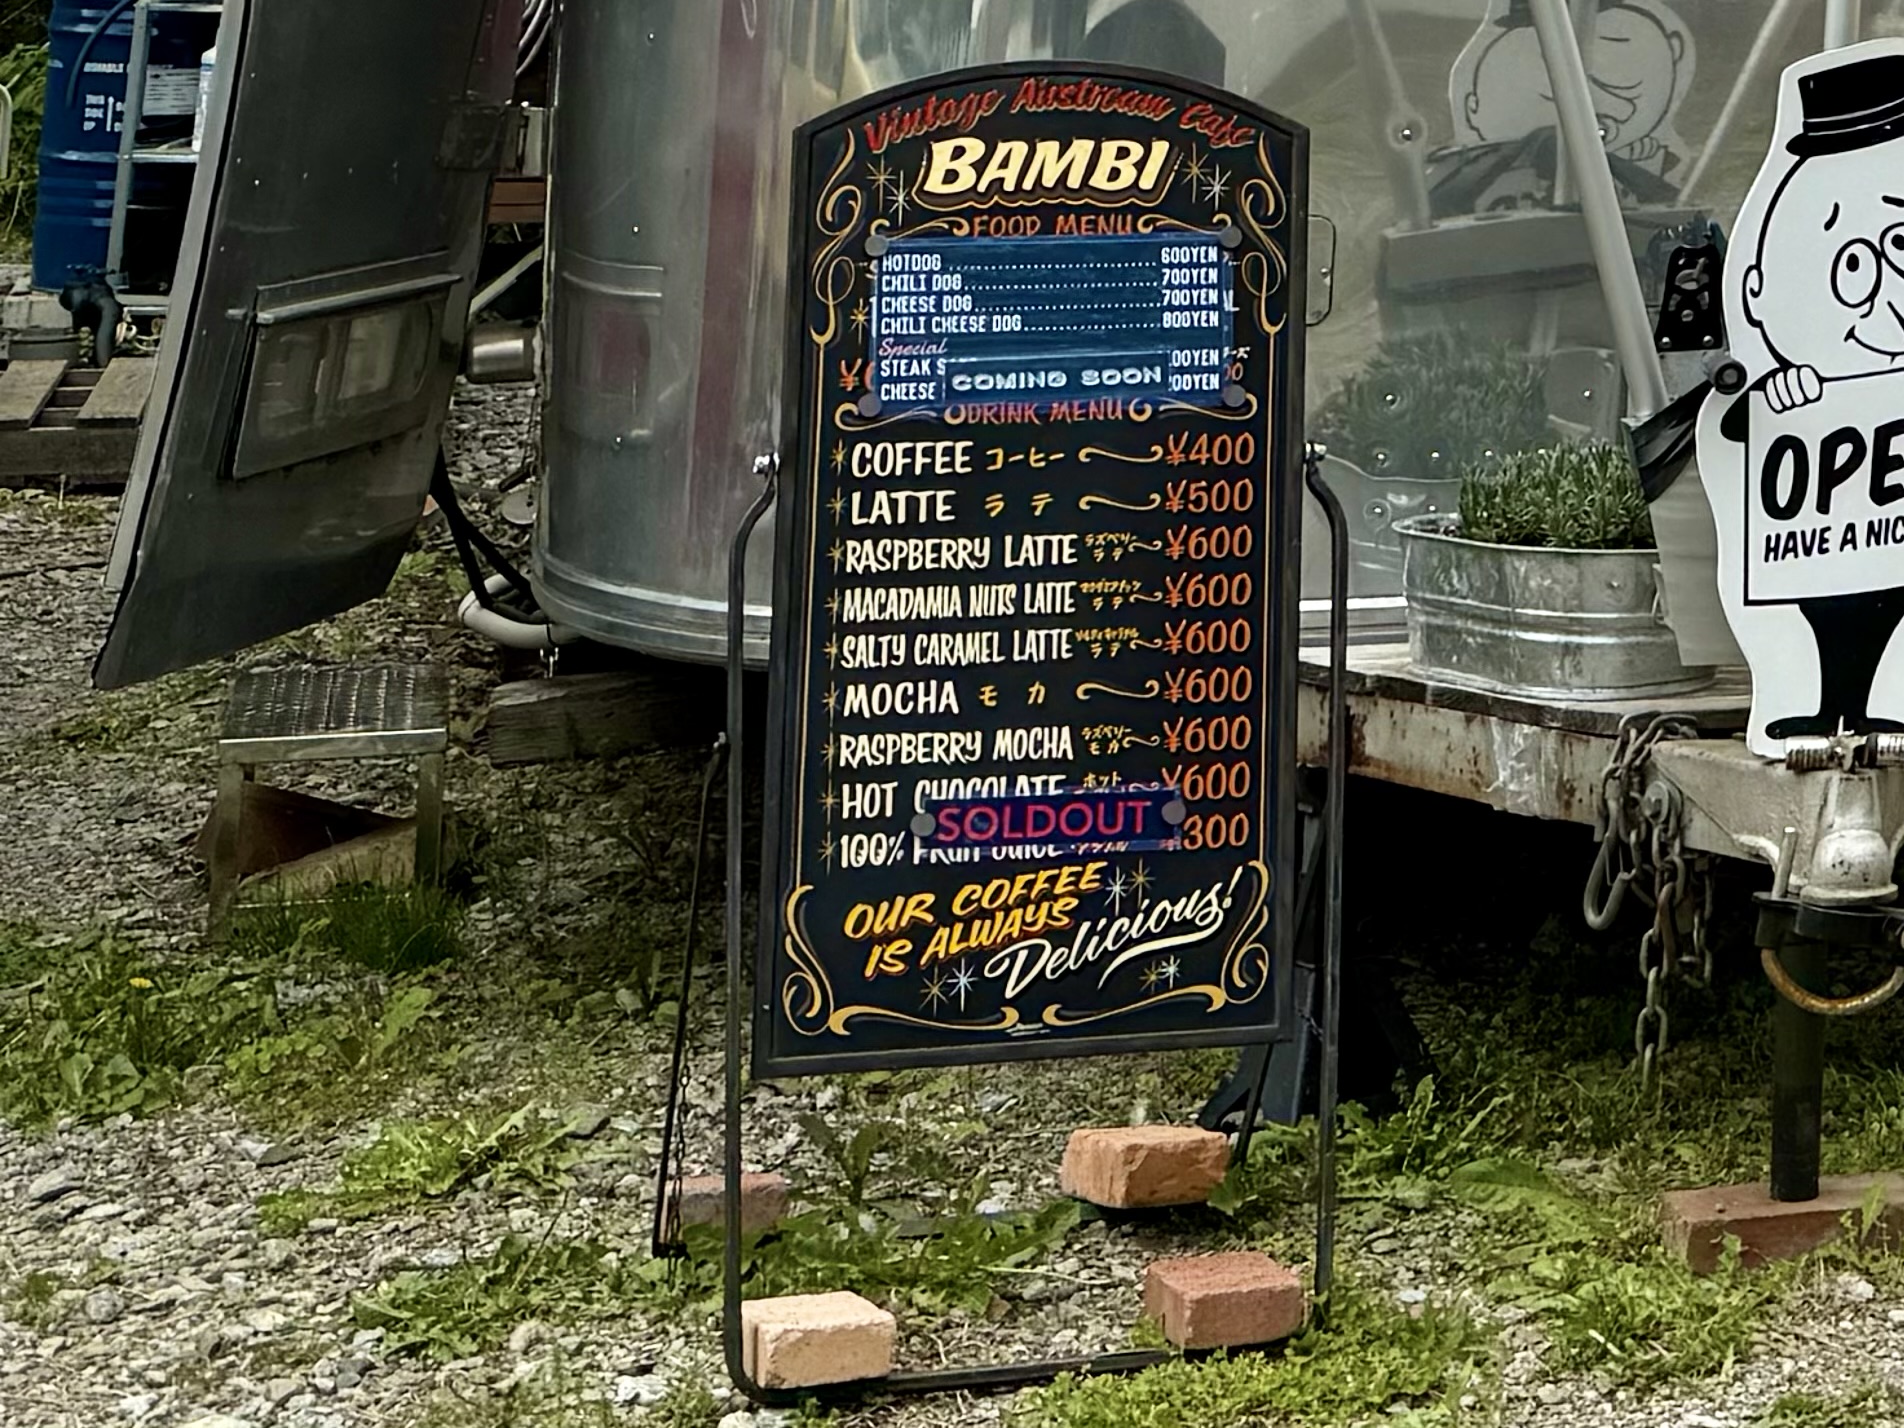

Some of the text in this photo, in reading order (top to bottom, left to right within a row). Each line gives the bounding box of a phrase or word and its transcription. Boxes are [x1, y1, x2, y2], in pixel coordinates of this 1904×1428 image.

[863, 89, 1006, 153] Vintage
[1011, 76, 1176, 121] Airstream
[923, 137, 1171, 195] BAMBI
[972, 213, 1134, 238] FOOD MENU
[882, 246, 1218, 272] HOTDOG 600YEN
[881, 268, 1218, 292] CHILI DOG 700YEN
[881, 295, 936, 314] CHEESE
[942, 295, 972, 312] DOG
[1162, 289, 1218, 306] 700YEN
[881, 311, 1219, 335] CHILI CHEESE DOG 800YEN
[878, 337, 948, 360] Special
[880, 359, 931, 377] STEAK
[1169, 349, 1219, 367] 00YEN
[880, 373, 1220, 401] CHEESE 00YEN
[952, 366, 1162, 391] COMING SOON
[966, 398, 1123, 425] DRINK MENU
[851, 431, 1255, 478] COFFEE コーヒー ¥400
[851, 490, 956, 525] LATTE
[1165, 478, 1254, 514] ¥500
[846, 533, 1078, 574] RASPBERRY LATTE
[1165, 524, 1252, 560] ¥600
[1764, 526, 1832, 563] HAVE
[1839, 522, 1857, 552] A
[842, 581, 1077, 623] MACADAMIA NUTS LATTE
[1164, 572, 1252, 608] ¥600
[840, 628, 1073, 669] SALTY CARAMEL LATTE
[1163, 618, 1251, 654] ¥600
[844, 680, 959, 719] MOCHA
[1164, 666, 1252, 703] ¥600
[839, 726, 1074, 769] RASPBERRY MOCHA
[1163, 715, 1251, 752] ¥600
[842, 782, 898, 819] HOT
[937, 800, 1152, 842] SOLDOUT
[841, 831, 905, 868] 100%
[843, 861, 1108, 940] OUR COFFEE
[864, 896, 1080, 978] IS ALWAYS
[984, 866, 1243, 1000] Delicious!
